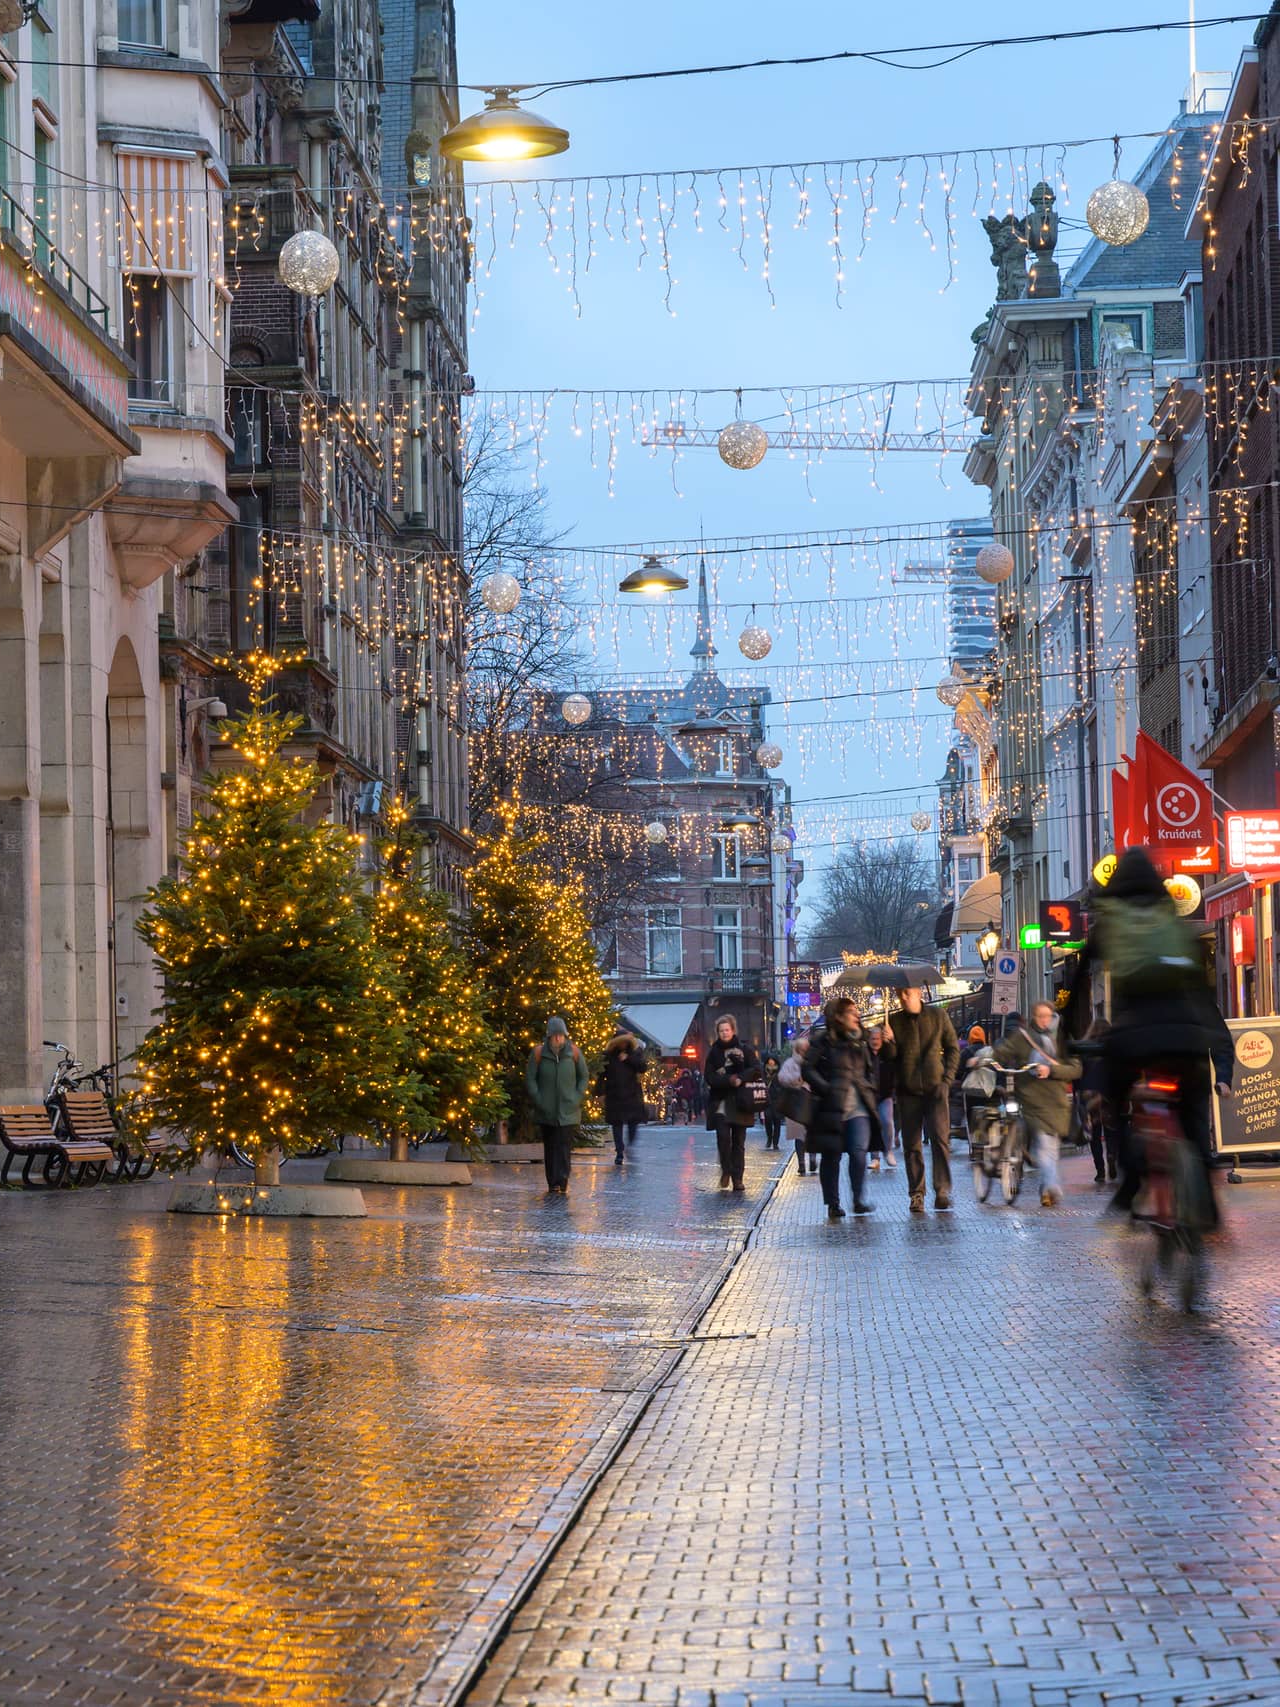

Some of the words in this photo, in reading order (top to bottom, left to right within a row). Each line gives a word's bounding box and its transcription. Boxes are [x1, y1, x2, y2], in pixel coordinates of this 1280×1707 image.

[1158, 829, 1202, 840] Kruidvat
[1242, 1040, 1265, 1051] ABC
[1241, 1071, 1272, 1086] BOOKS
[1234, 1078, 1280, 1098] MAGAZINES
[1243, 1089, 1277, 1105] MANGA
[1246, 1109, 1277, 1123] GAMES
[1245, 1125, 1252, 1135] &
[1253, 1118, 1276, 1132] MORE
